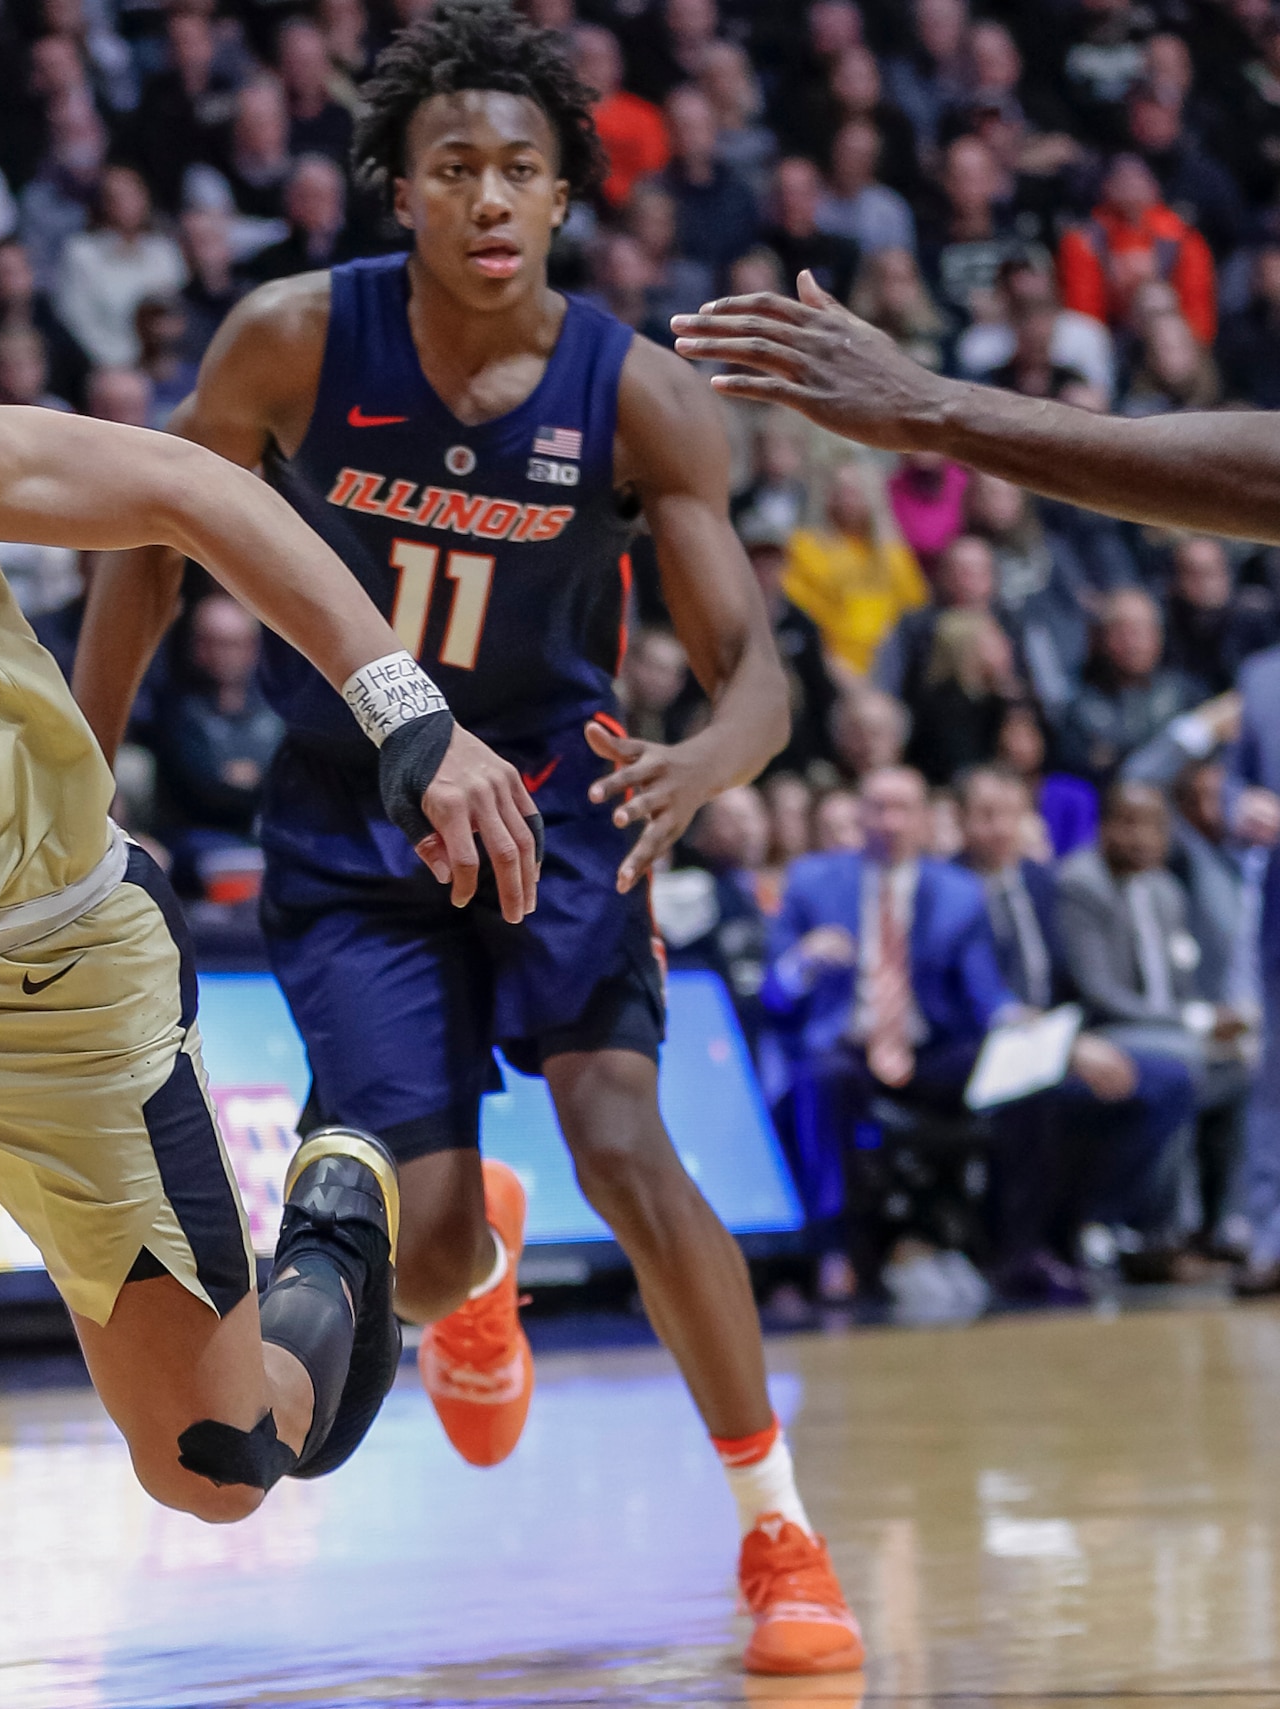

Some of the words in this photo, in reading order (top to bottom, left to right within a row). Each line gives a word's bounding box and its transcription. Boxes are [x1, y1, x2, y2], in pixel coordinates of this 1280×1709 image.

[326, 467, 576, 543] ILLINOIS
[389, 537, 497, 672] 11
[399, 694, 443, 721] OUT
